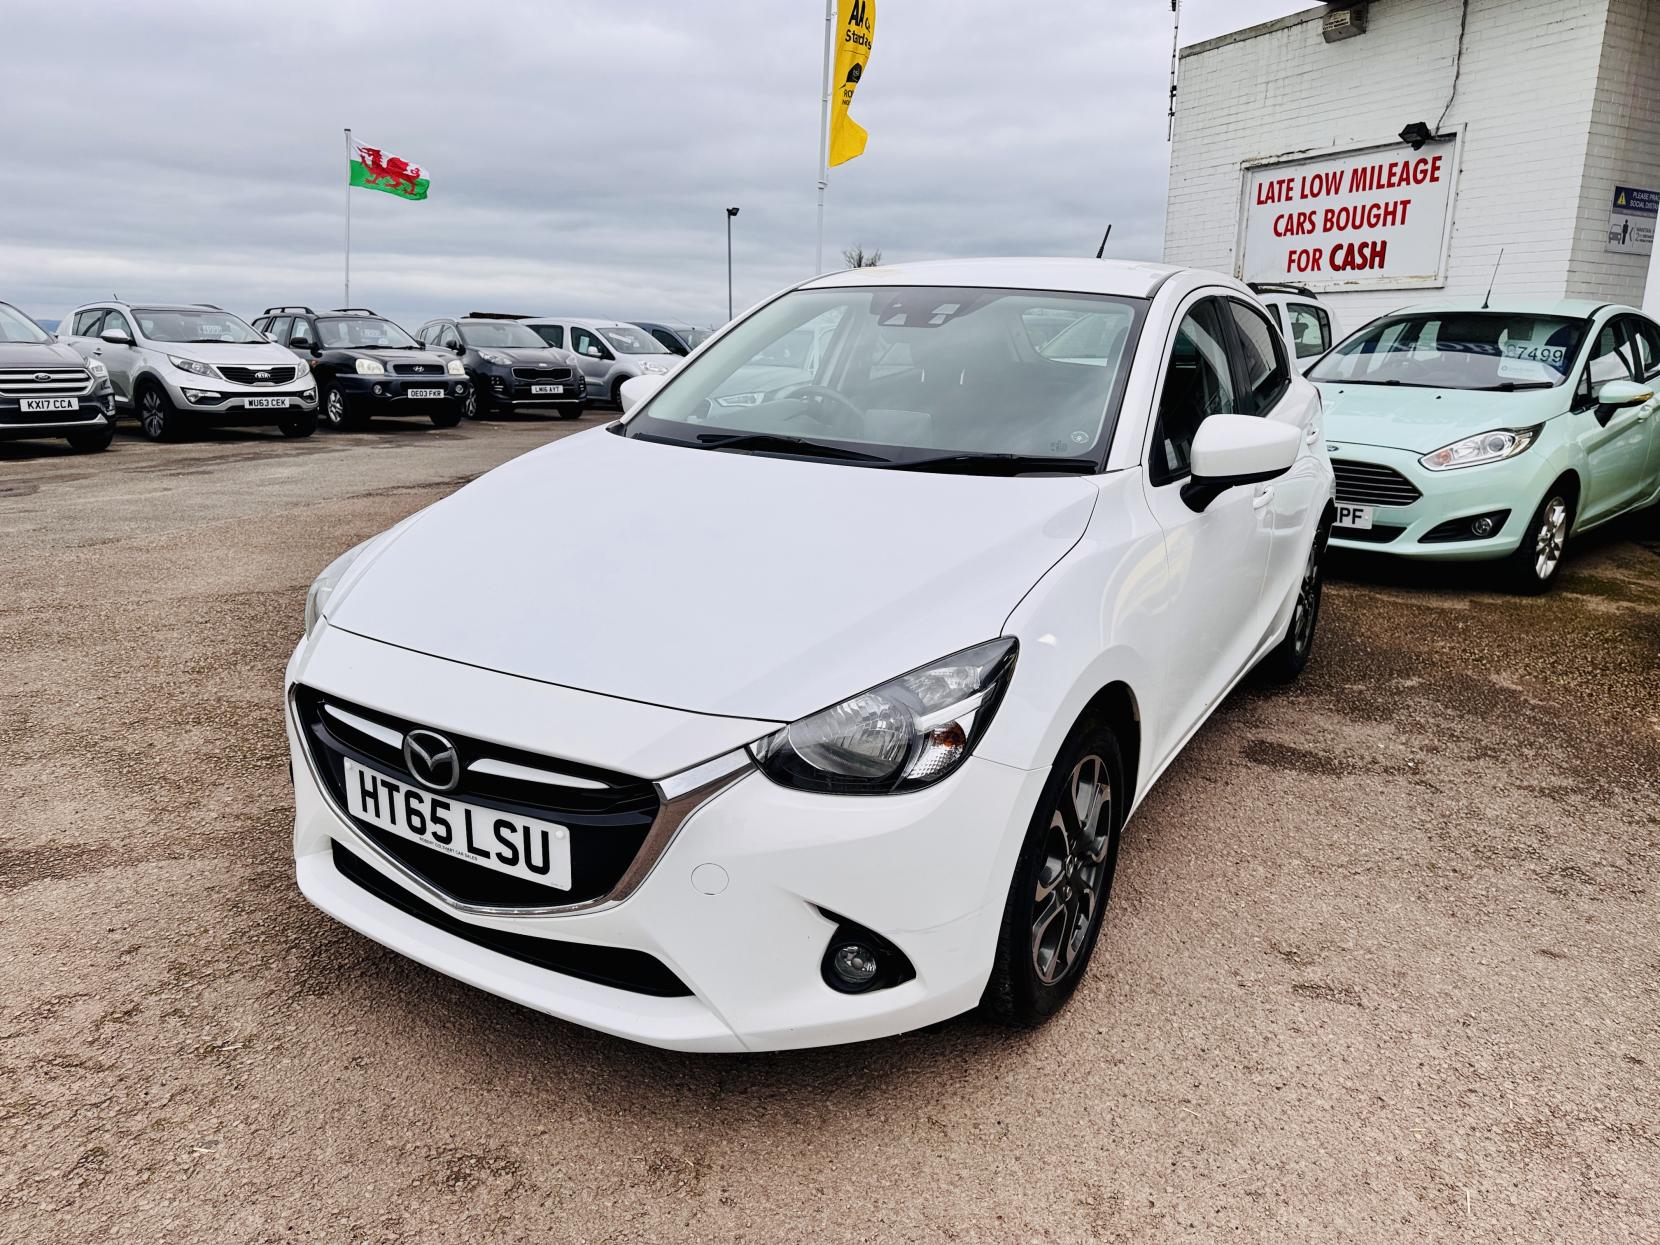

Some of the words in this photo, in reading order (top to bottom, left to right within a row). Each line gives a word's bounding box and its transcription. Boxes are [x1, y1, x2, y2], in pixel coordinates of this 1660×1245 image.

[1256, 178, 1295, 205] LATE
[1300, 170, 1345, 200] LOW
[1348, 155, 1443, 194] MILEAGE
[1632, 191, 1649, 200] PLEASE
[1273, 210, 1317, 238] CARS
[1322, 199, 1412, 233] BOUGHT
[1286, 248, 1323, 273] FOR
[1329, 240, 1387, 272] CASH
[27, 400, 51, 410] KX17
[53, 399, 73, 409] CCA
[271, 398, 286, 407] CEK
[358, 769, 453, 846] HT65
[464, 808, 551, 876] LSU
